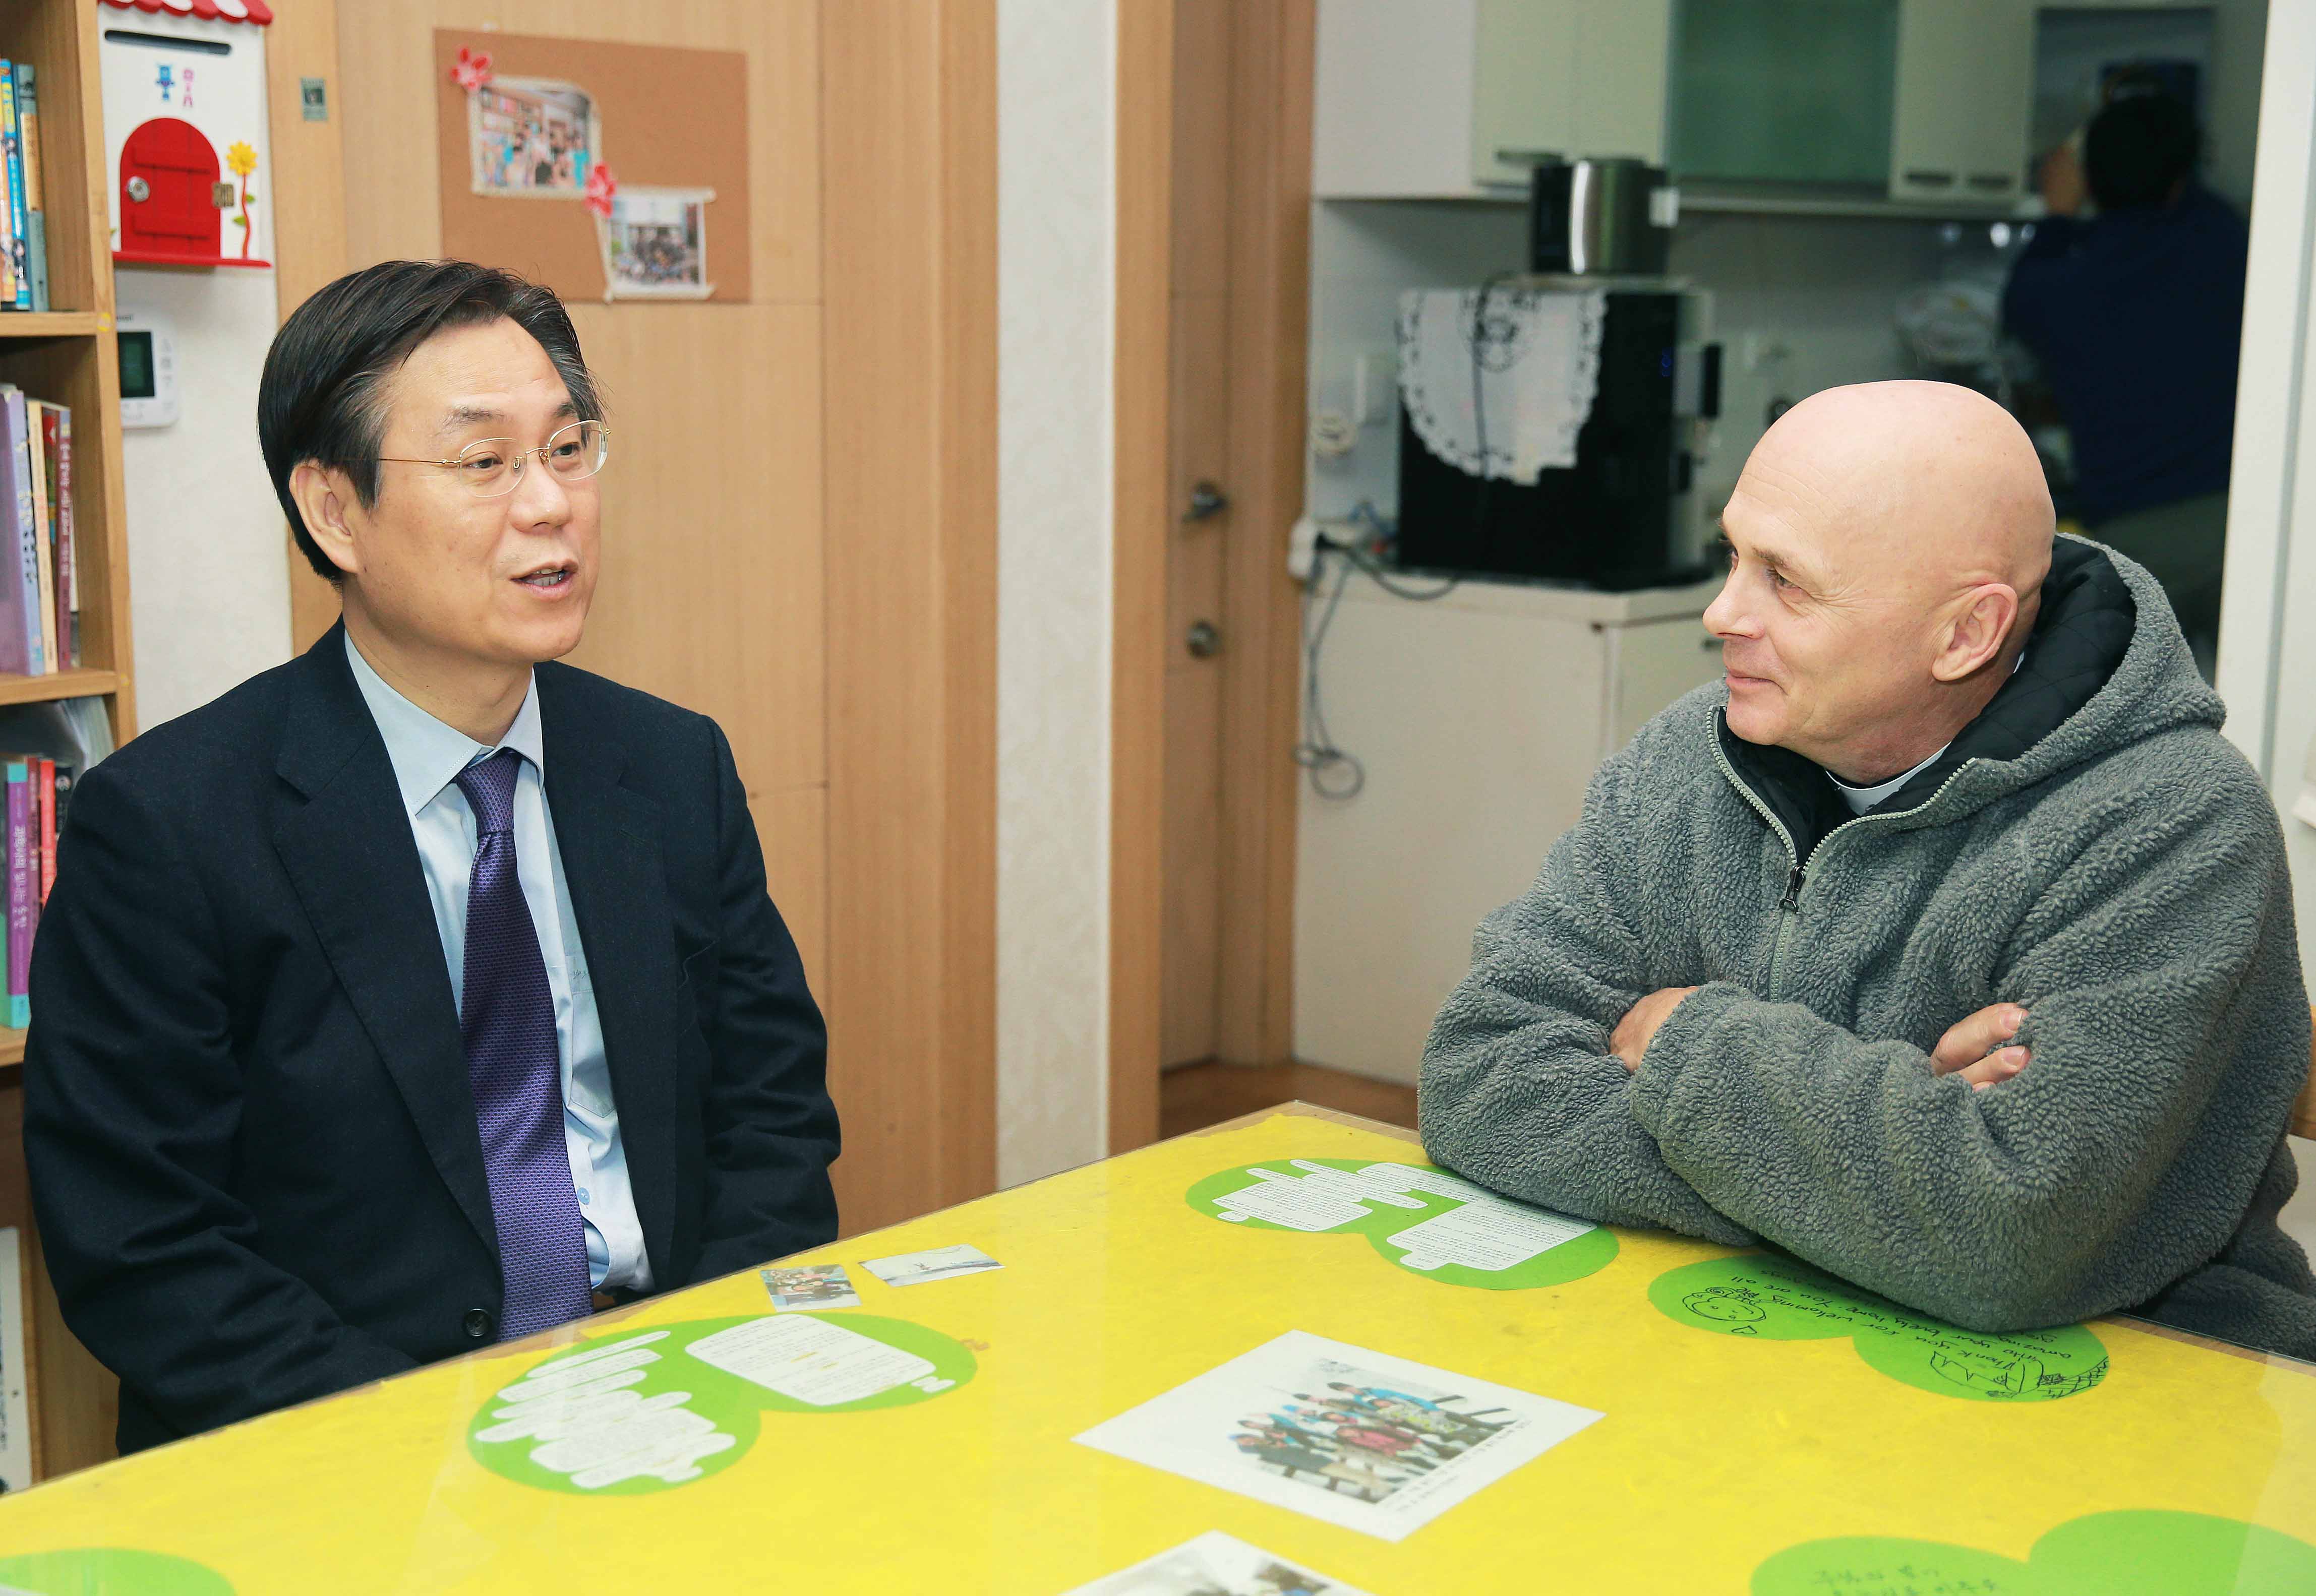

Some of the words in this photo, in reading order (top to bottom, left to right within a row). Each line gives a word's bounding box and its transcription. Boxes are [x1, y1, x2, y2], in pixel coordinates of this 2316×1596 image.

[1731, 1276, 1757, 1284] all
[1800, 1293, 1833, 1308] You
[1772, 1295, 1853, 1322] welcoming
[1860, 1323, 1900, 1335] for
[1916, 1336, 1959, 1349] you
[1949, 1335, 1998, 1348] your
[1997, 1334, 2071, 1359] amazing
[1957, 1349, 2016, 1371] Thank
[2002, 1349, 2038, 1363] into
